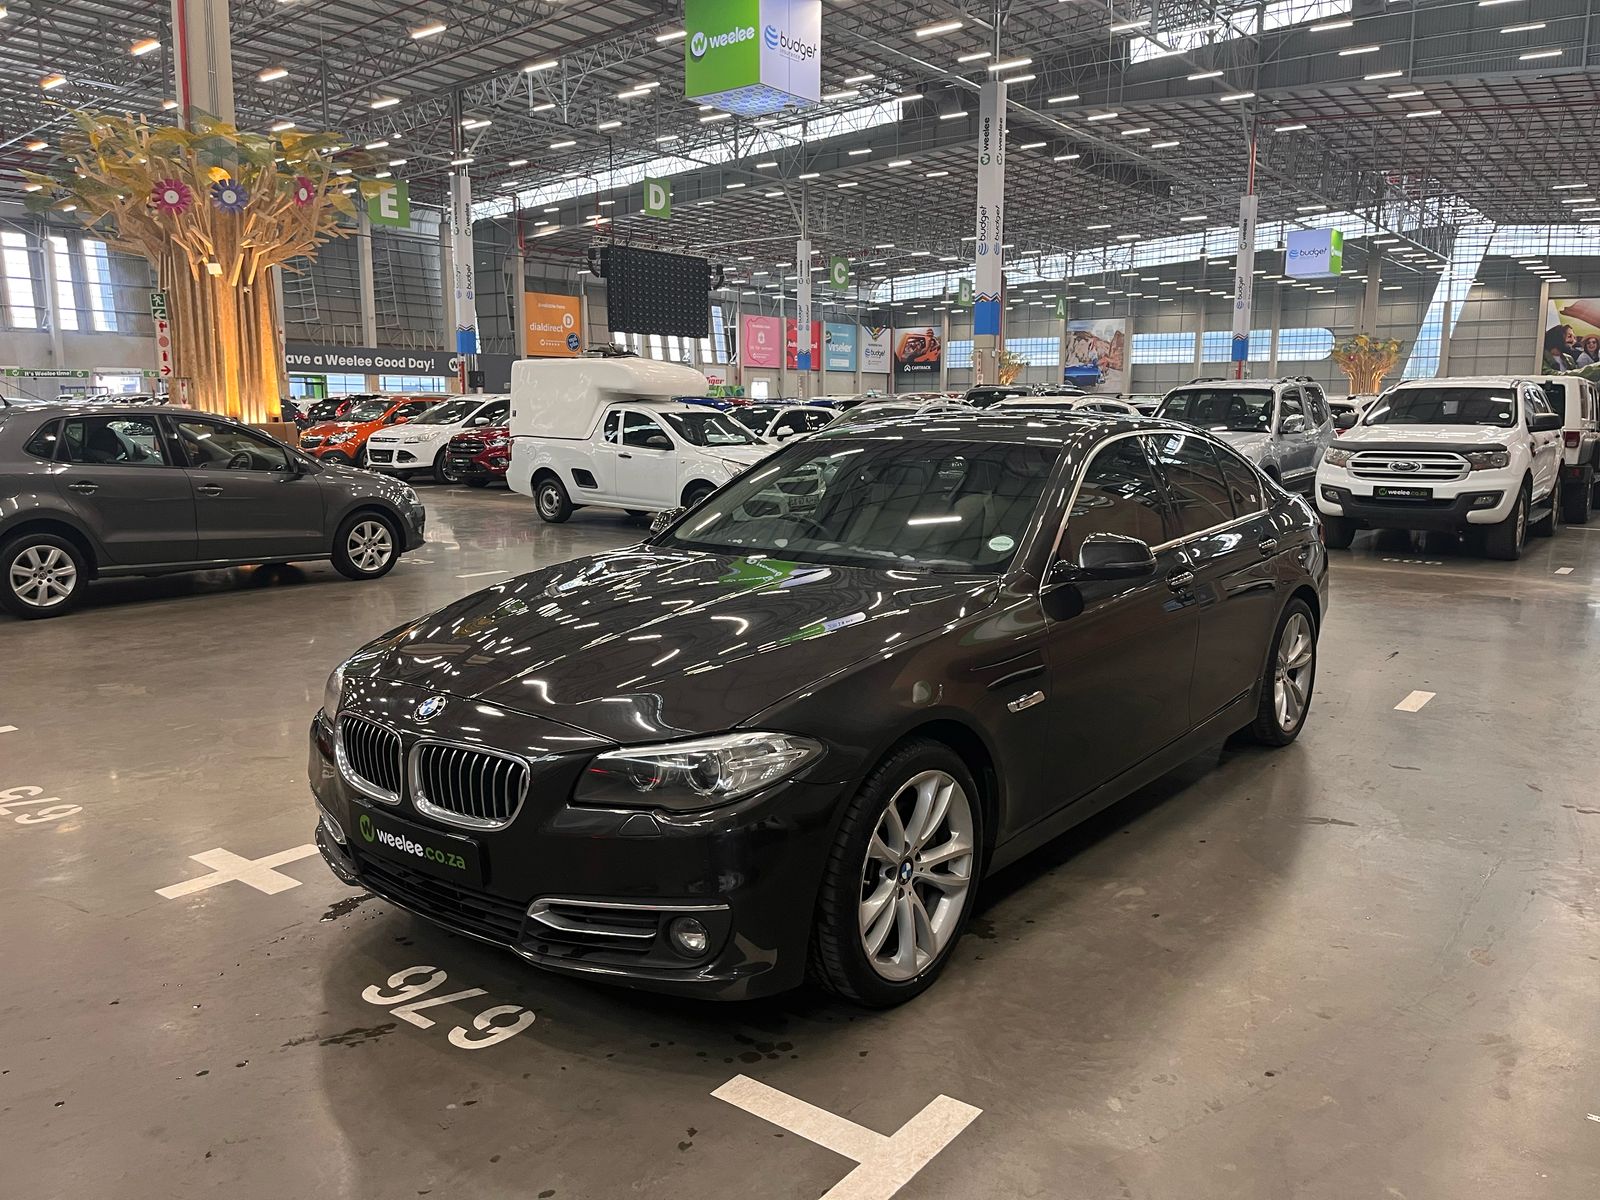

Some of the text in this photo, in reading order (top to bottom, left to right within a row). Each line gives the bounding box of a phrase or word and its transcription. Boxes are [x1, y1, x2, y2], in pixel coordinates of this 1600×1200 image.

[709, 26, 755, 49] weelee
[780, 31, 817, 61] budget
[380, 187, 399, 219] E
[649, 183, 666, 210] D
[979, 205, 990, 241] budget
[1299, 247, 1328, 258] budget
[833, 262, 846, 284] C
[961, 283, 970, 302] B
[1056, 299, 1065, 316] A
[529, 322, 564, 333] dialdirect
[286, 354, 311, 365] ave
[313, 355, 323, 365] a
[325, 354, 372, 367] Weelee
[374, 356, 406, 369] Good
[408, 357, 435, 372] Day!
[376, 828, 466, 870] weelee.co.za
[361, 965, 536, 1050] 676
